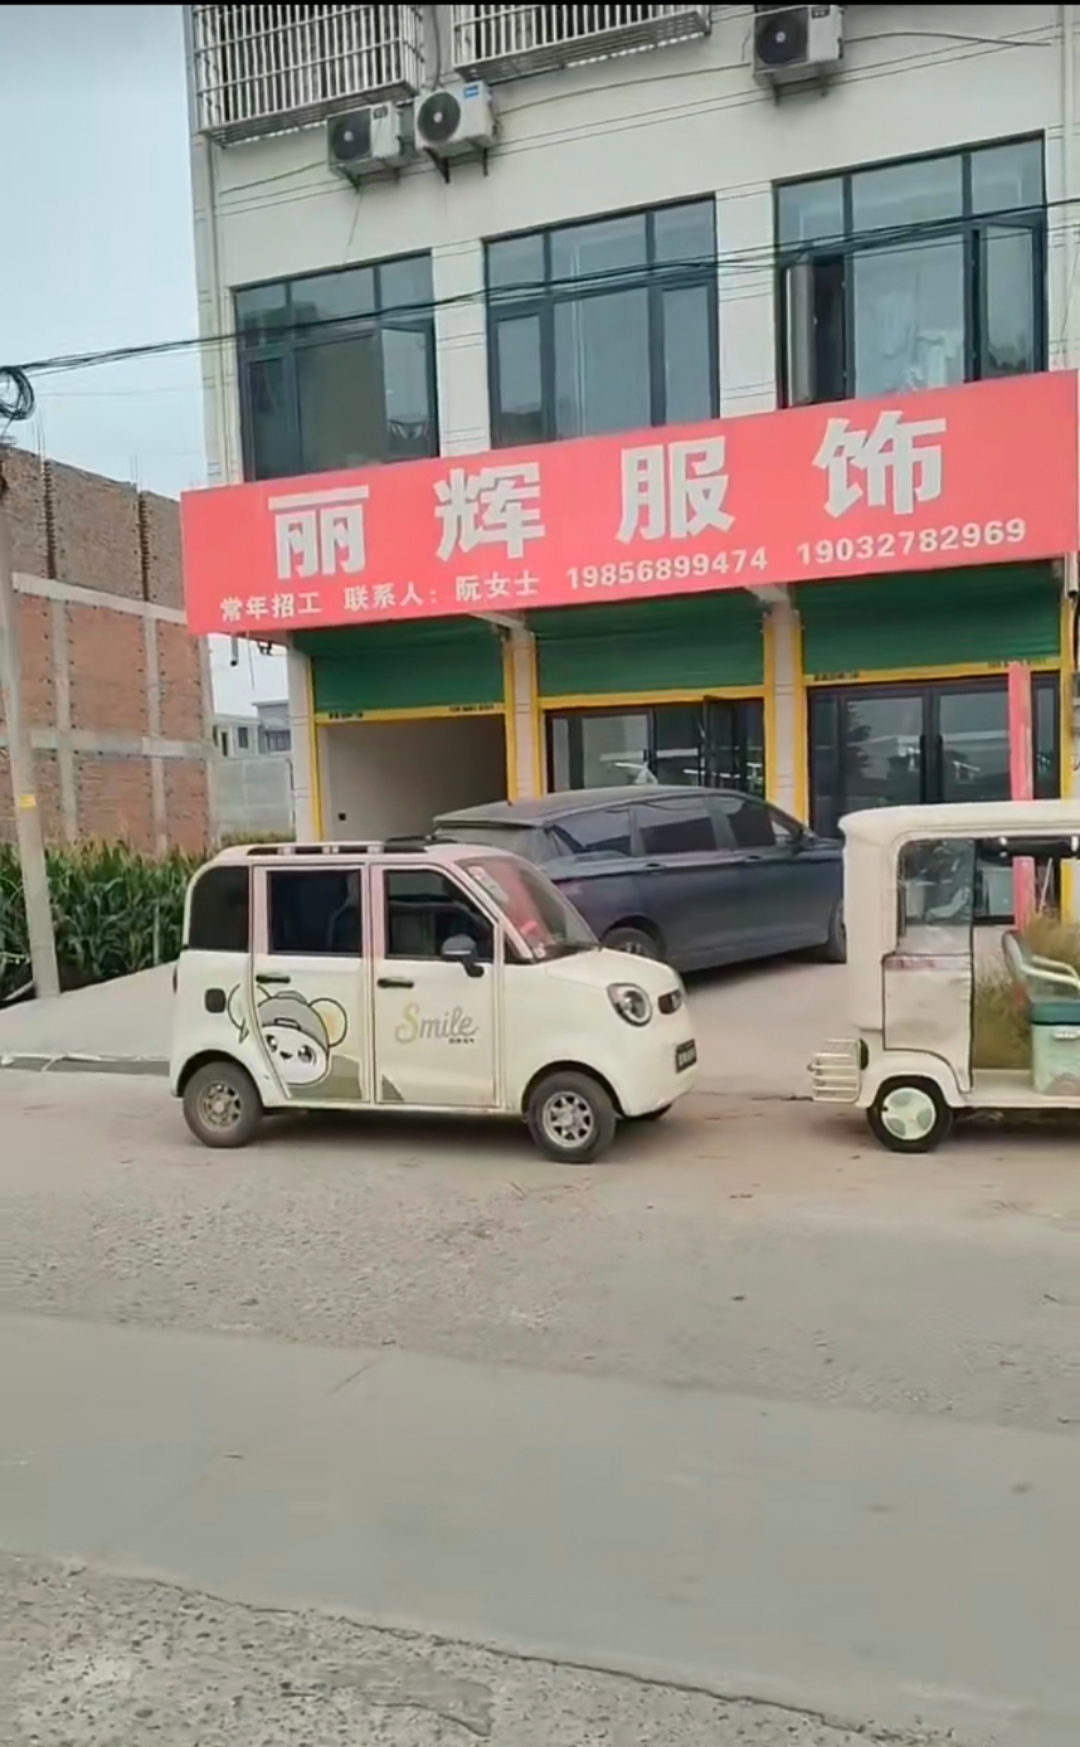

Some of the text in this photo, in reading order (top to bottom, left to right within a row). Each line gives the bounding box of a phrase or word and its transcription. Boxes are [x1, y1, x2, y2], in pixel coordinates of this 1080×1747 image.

[268, 410, 947, 579] 丽辉服饰
[220, 591, 322, 621] 常年招工
[566, 546, 768, 589] 19856899474
[797, 517, 1027, 566] 19032782969
[394, 1002, 480, 1044] Smile
